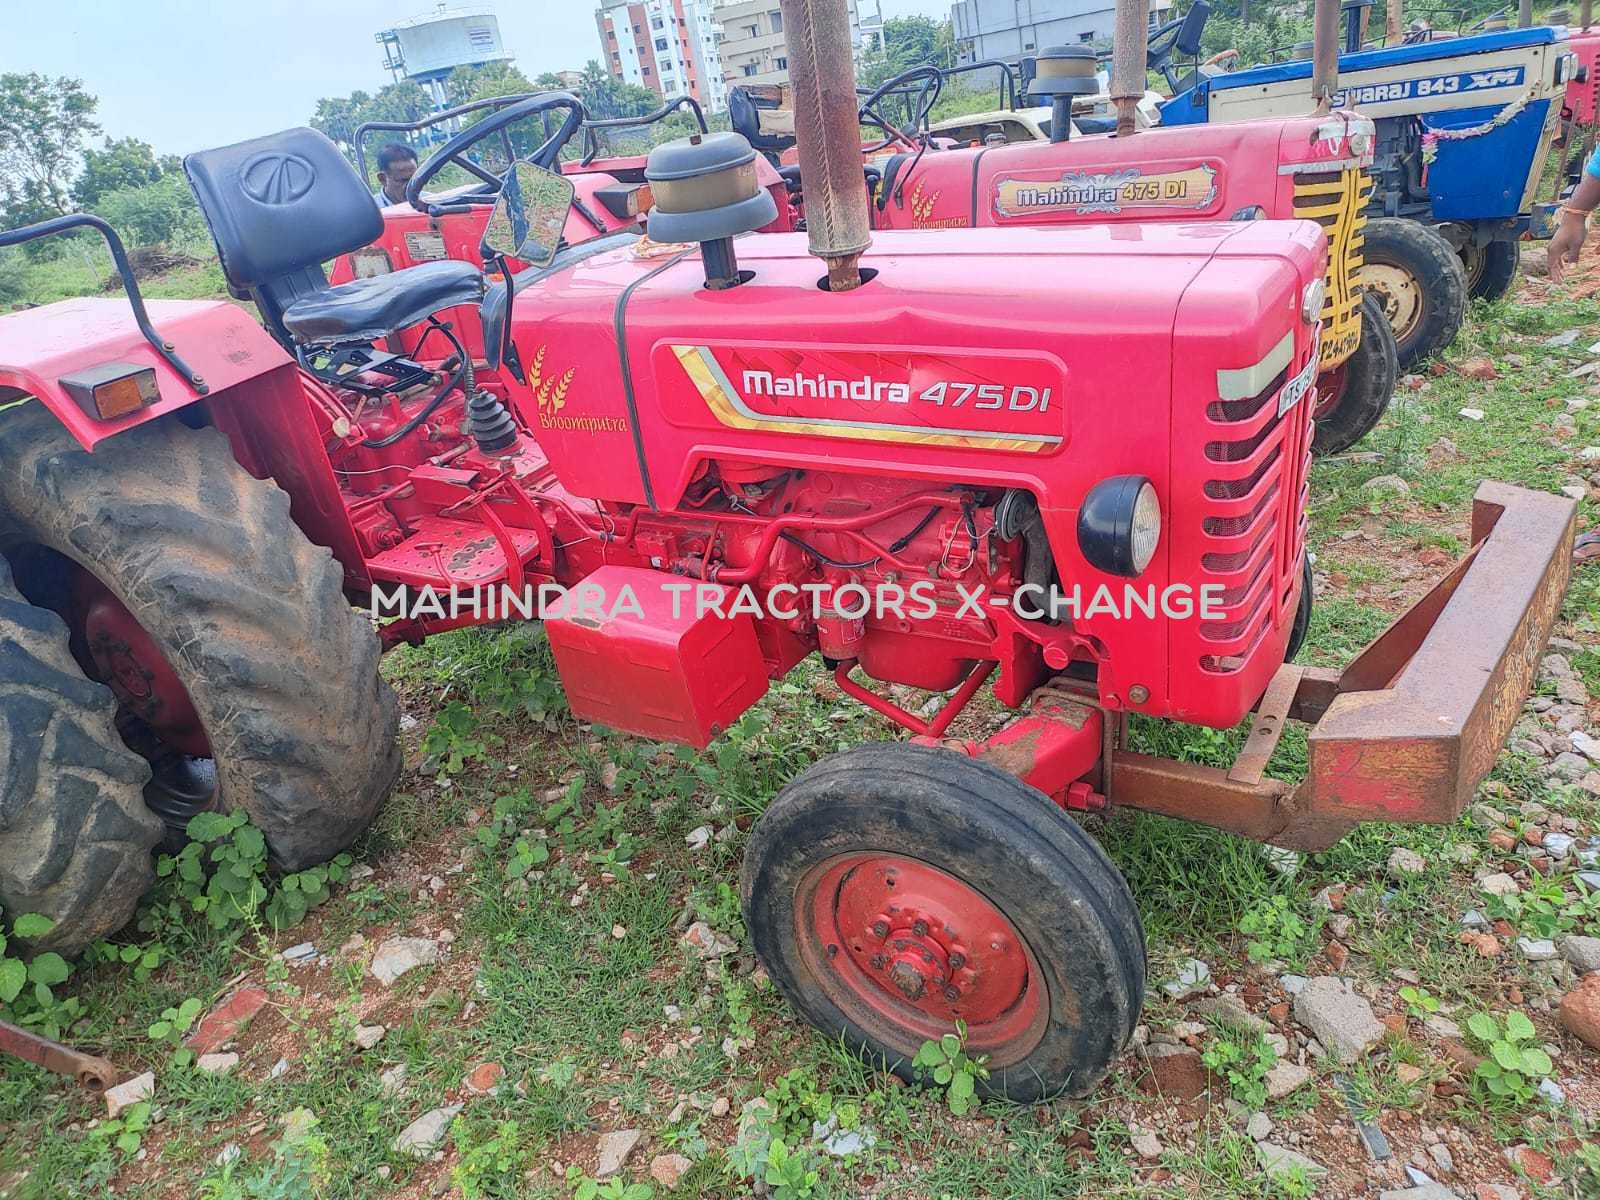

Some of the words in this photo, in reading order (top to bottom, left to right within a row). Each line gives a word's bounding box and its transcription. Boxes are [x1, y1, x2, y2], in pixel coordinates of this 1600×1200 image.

[1417, 77, 1459, 95] 843
[1465, 69, 1519, 89] XM
[1016, 186, 1117, 207] Mahindra
[1122, 181, 1159, 200] 475
[1164, 180, 1187, 199] DI
[743, 370, 909, 402] Mahindra
[539, 413, 628, 437] Bhoomiputra
